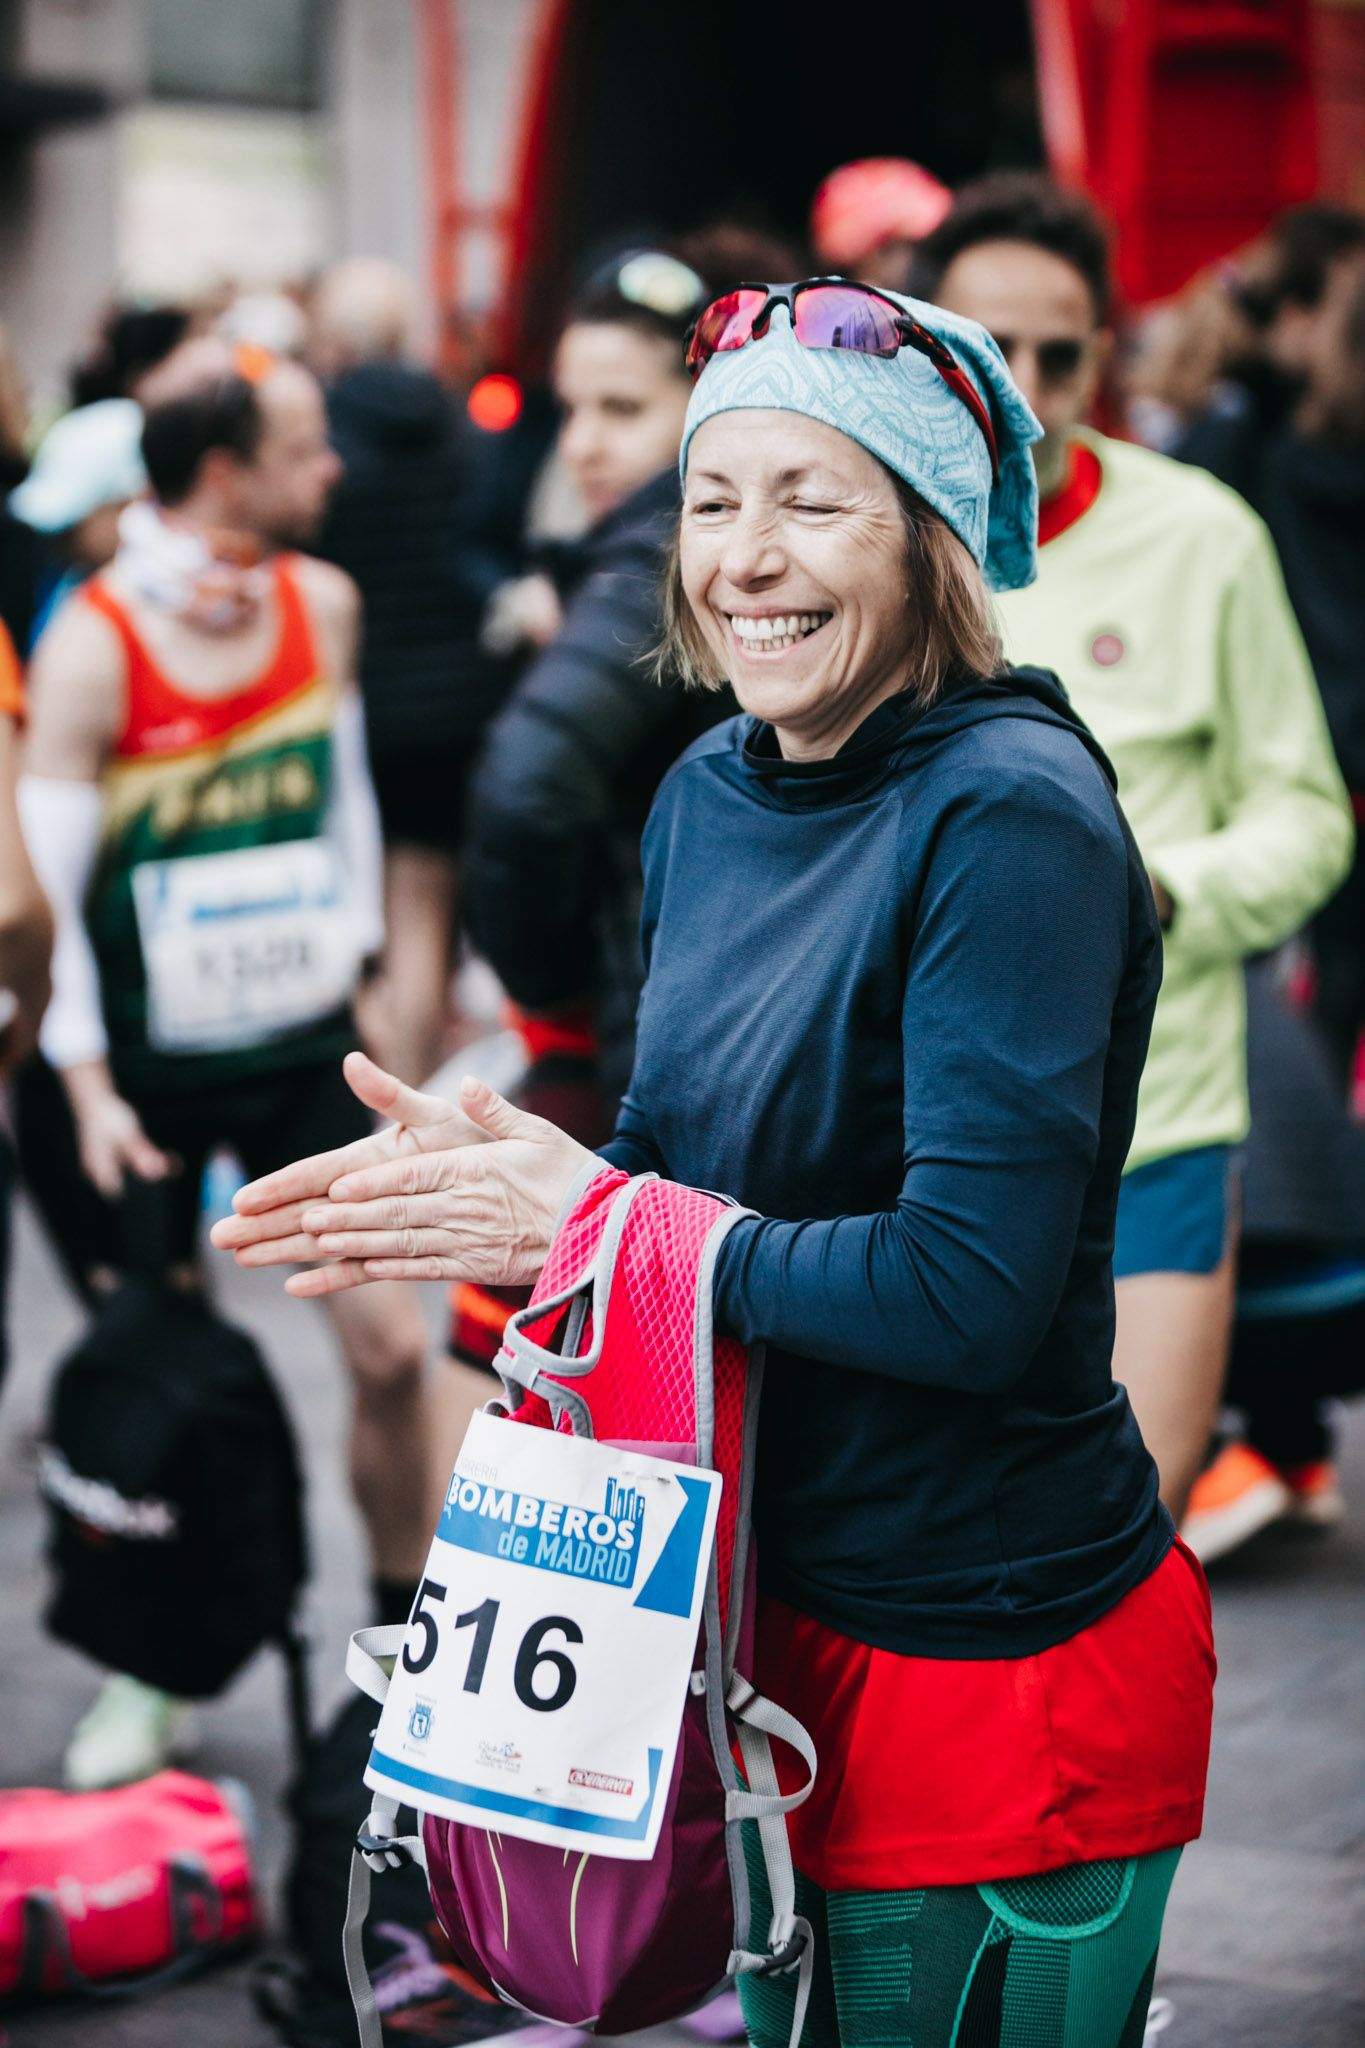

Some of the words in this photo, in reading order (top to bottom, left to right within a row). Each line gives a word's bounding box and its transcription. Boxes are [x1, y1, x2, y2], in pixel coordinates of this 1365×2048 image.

[447, 1474, 636, 1551] BOMBEROS
[497, 1524, 529, 1561] de
[534, 1532, 632, 1584] MADRID
[402, 1577, 584, 1713] 516
